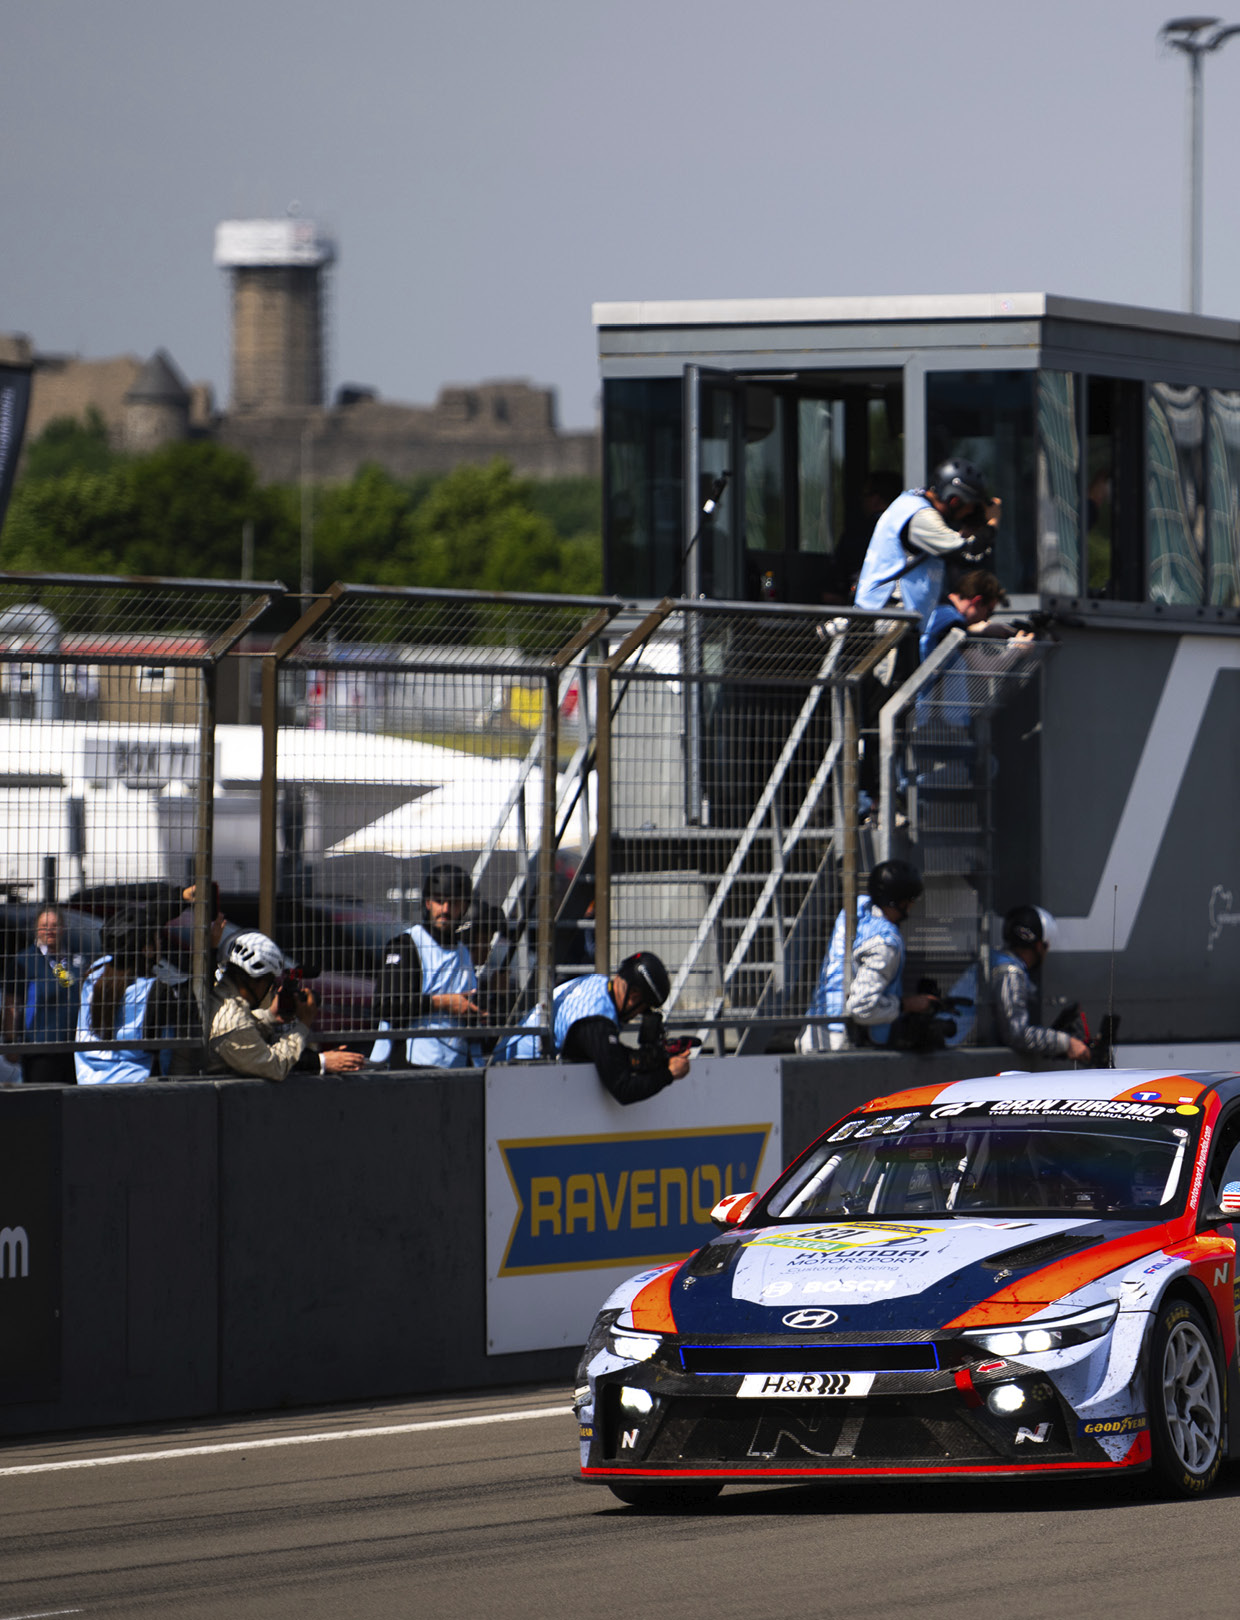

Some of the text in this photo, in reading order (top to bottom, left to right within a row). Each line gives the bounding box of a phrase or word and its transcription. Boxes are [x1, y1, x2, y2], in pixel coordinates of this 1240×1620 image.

[991, 1099, 1166, 1117] GRAN TURISMO
[1089, 1112, 1154, 1122] SIMULATOR
[1189, 1124, 1212, 1210] motorsport.hyundai.com
[797, 1227, 870, 1244] 831
[779, 1239, 837, 1251] DEKRA
[795, 1250, 929, 1258] HYUNDAI
[787, 1257, 920, 1266] MOTORSPORT
[787, 1265, 852, 1273] Customer
[802, 1280, 896, 1294] BOSCH
[762, 1375, 817, 1394] H&R
[1084, 1416, 1147, 1434] GOODYEAR
